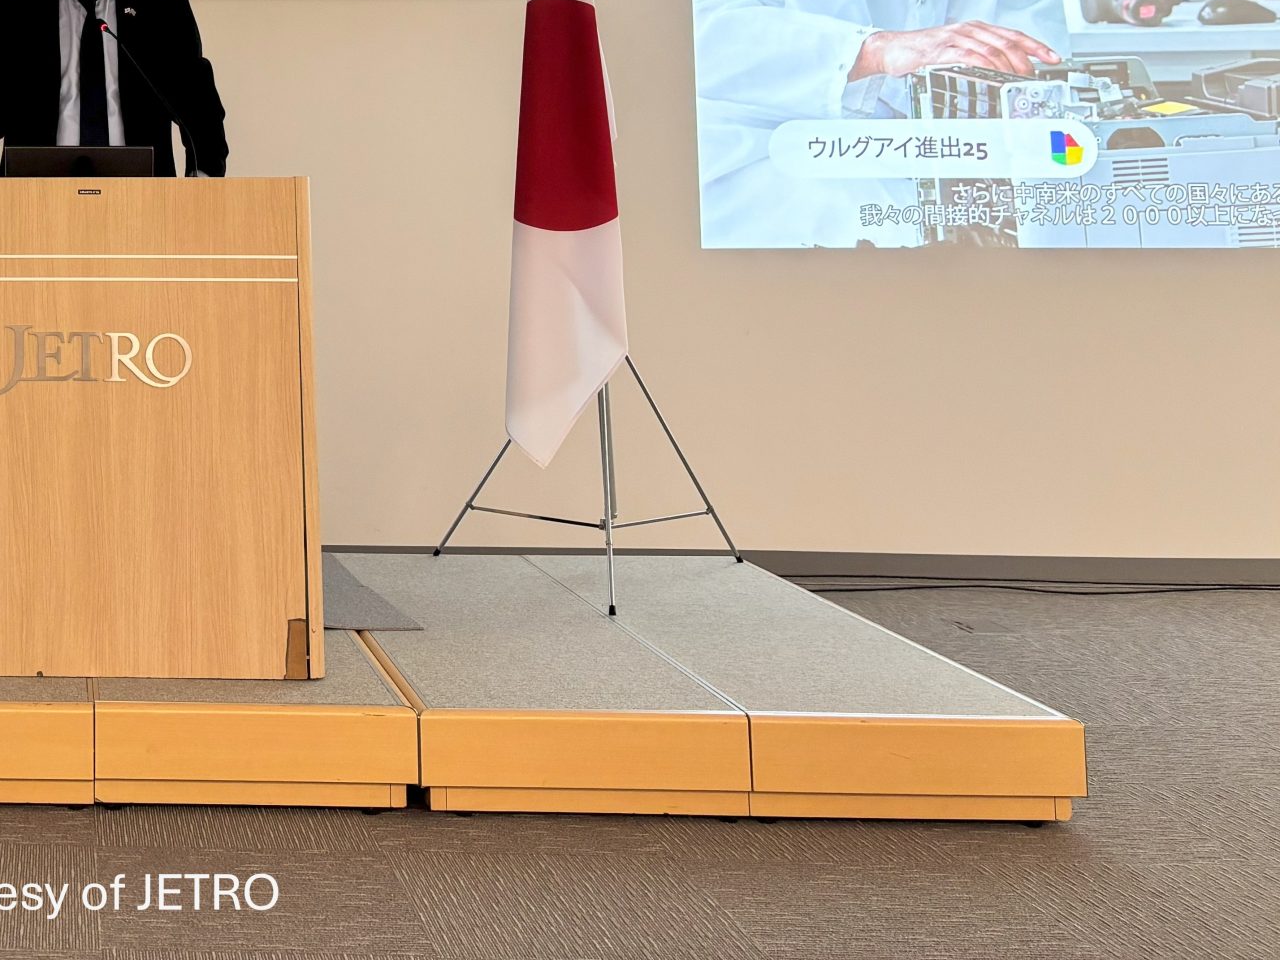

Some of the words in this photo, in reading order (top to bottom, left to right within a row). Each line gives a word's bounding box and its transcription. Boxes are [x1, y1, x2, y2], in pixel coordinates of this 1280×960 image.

[807, 133, 989, 161] ウルグアイ進出25
